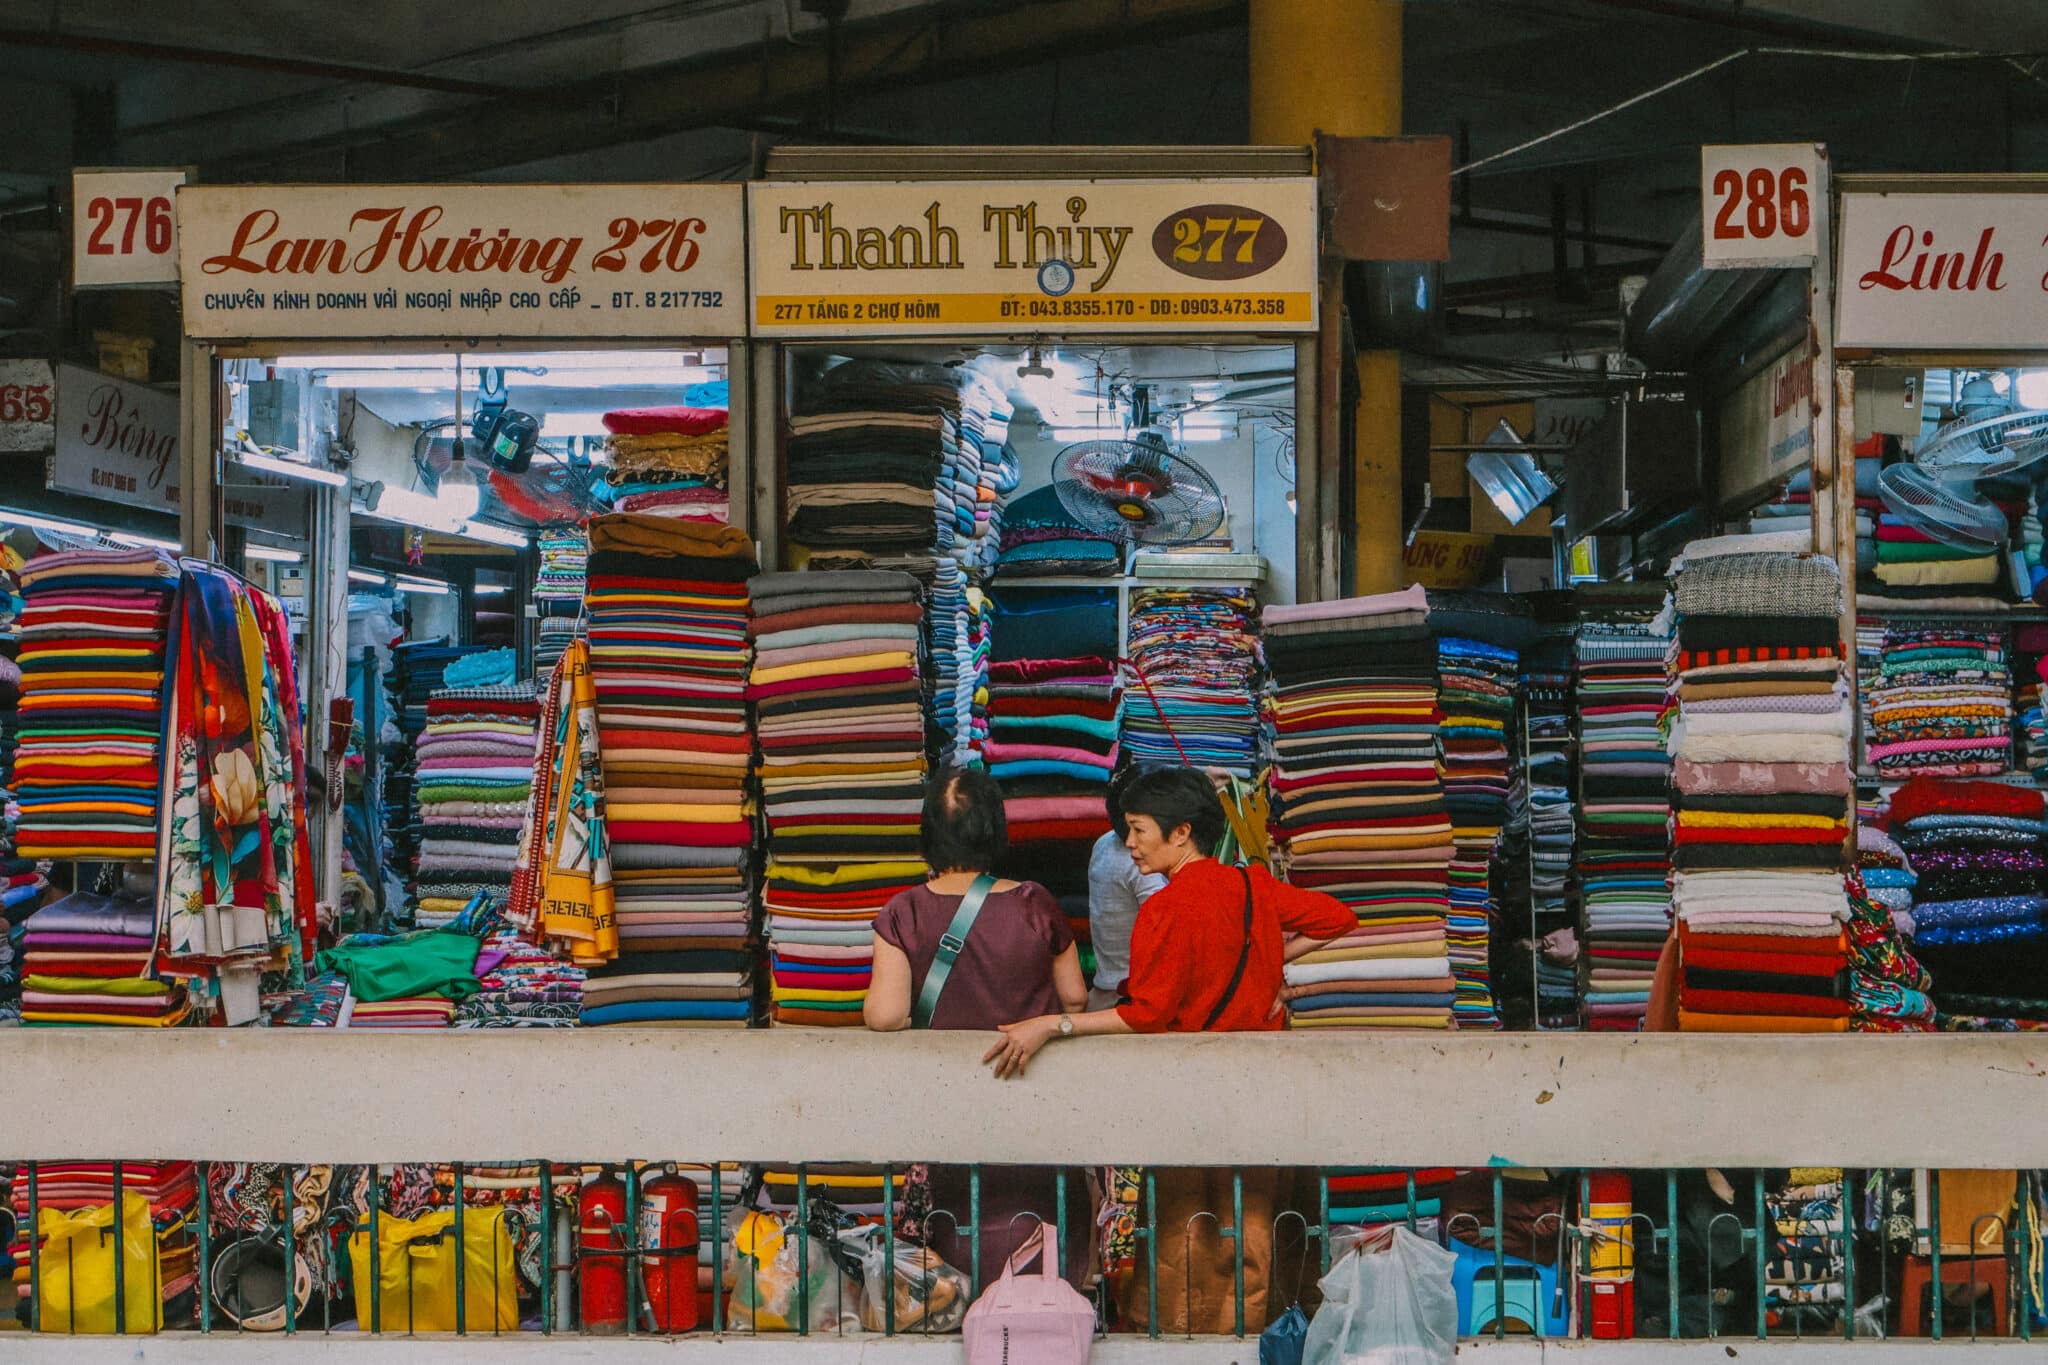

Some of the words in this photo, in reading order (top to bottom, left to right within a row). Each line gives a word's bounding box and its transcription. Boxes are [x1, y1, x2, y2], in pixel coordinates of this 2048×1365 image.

[87, 196, 172, 255] 276
[1713, 166, 1810, 240] 286
[201, 208, 350, 276] Lan
[350, 205, 585, 285] Hương
[592, 217, 707, 274] 276
[779, 201, 965, 271] Thanh
[983, 196, 1134, 293] Thủy
[1173, 215, 1264, 264] 277
[1858, 224, 2007, 291] Linh
[205, 287, 265, 310] CHUYÊN
[317, 292, 367, 310] DOANH
[405, 288, 452, 312] NGOẠI
[460, 287, 502, 312] NHẬP
[509, 292, 541, 309] CAO
[549, 285, 581, 309] CẤP
[774, 303, 803, 320] 277
[853, 303, 863, 319] 2
[868, 301, 900, 322] CHỢ
[904, 299, 940, 320] HÔM
[1029, 300, 1135, 317] 043.8355.170
[1180, 298, 1285, 316] 0903.473.358
[0, 383, 52, 423] 65
[82, 384, 177, 489] Bông
